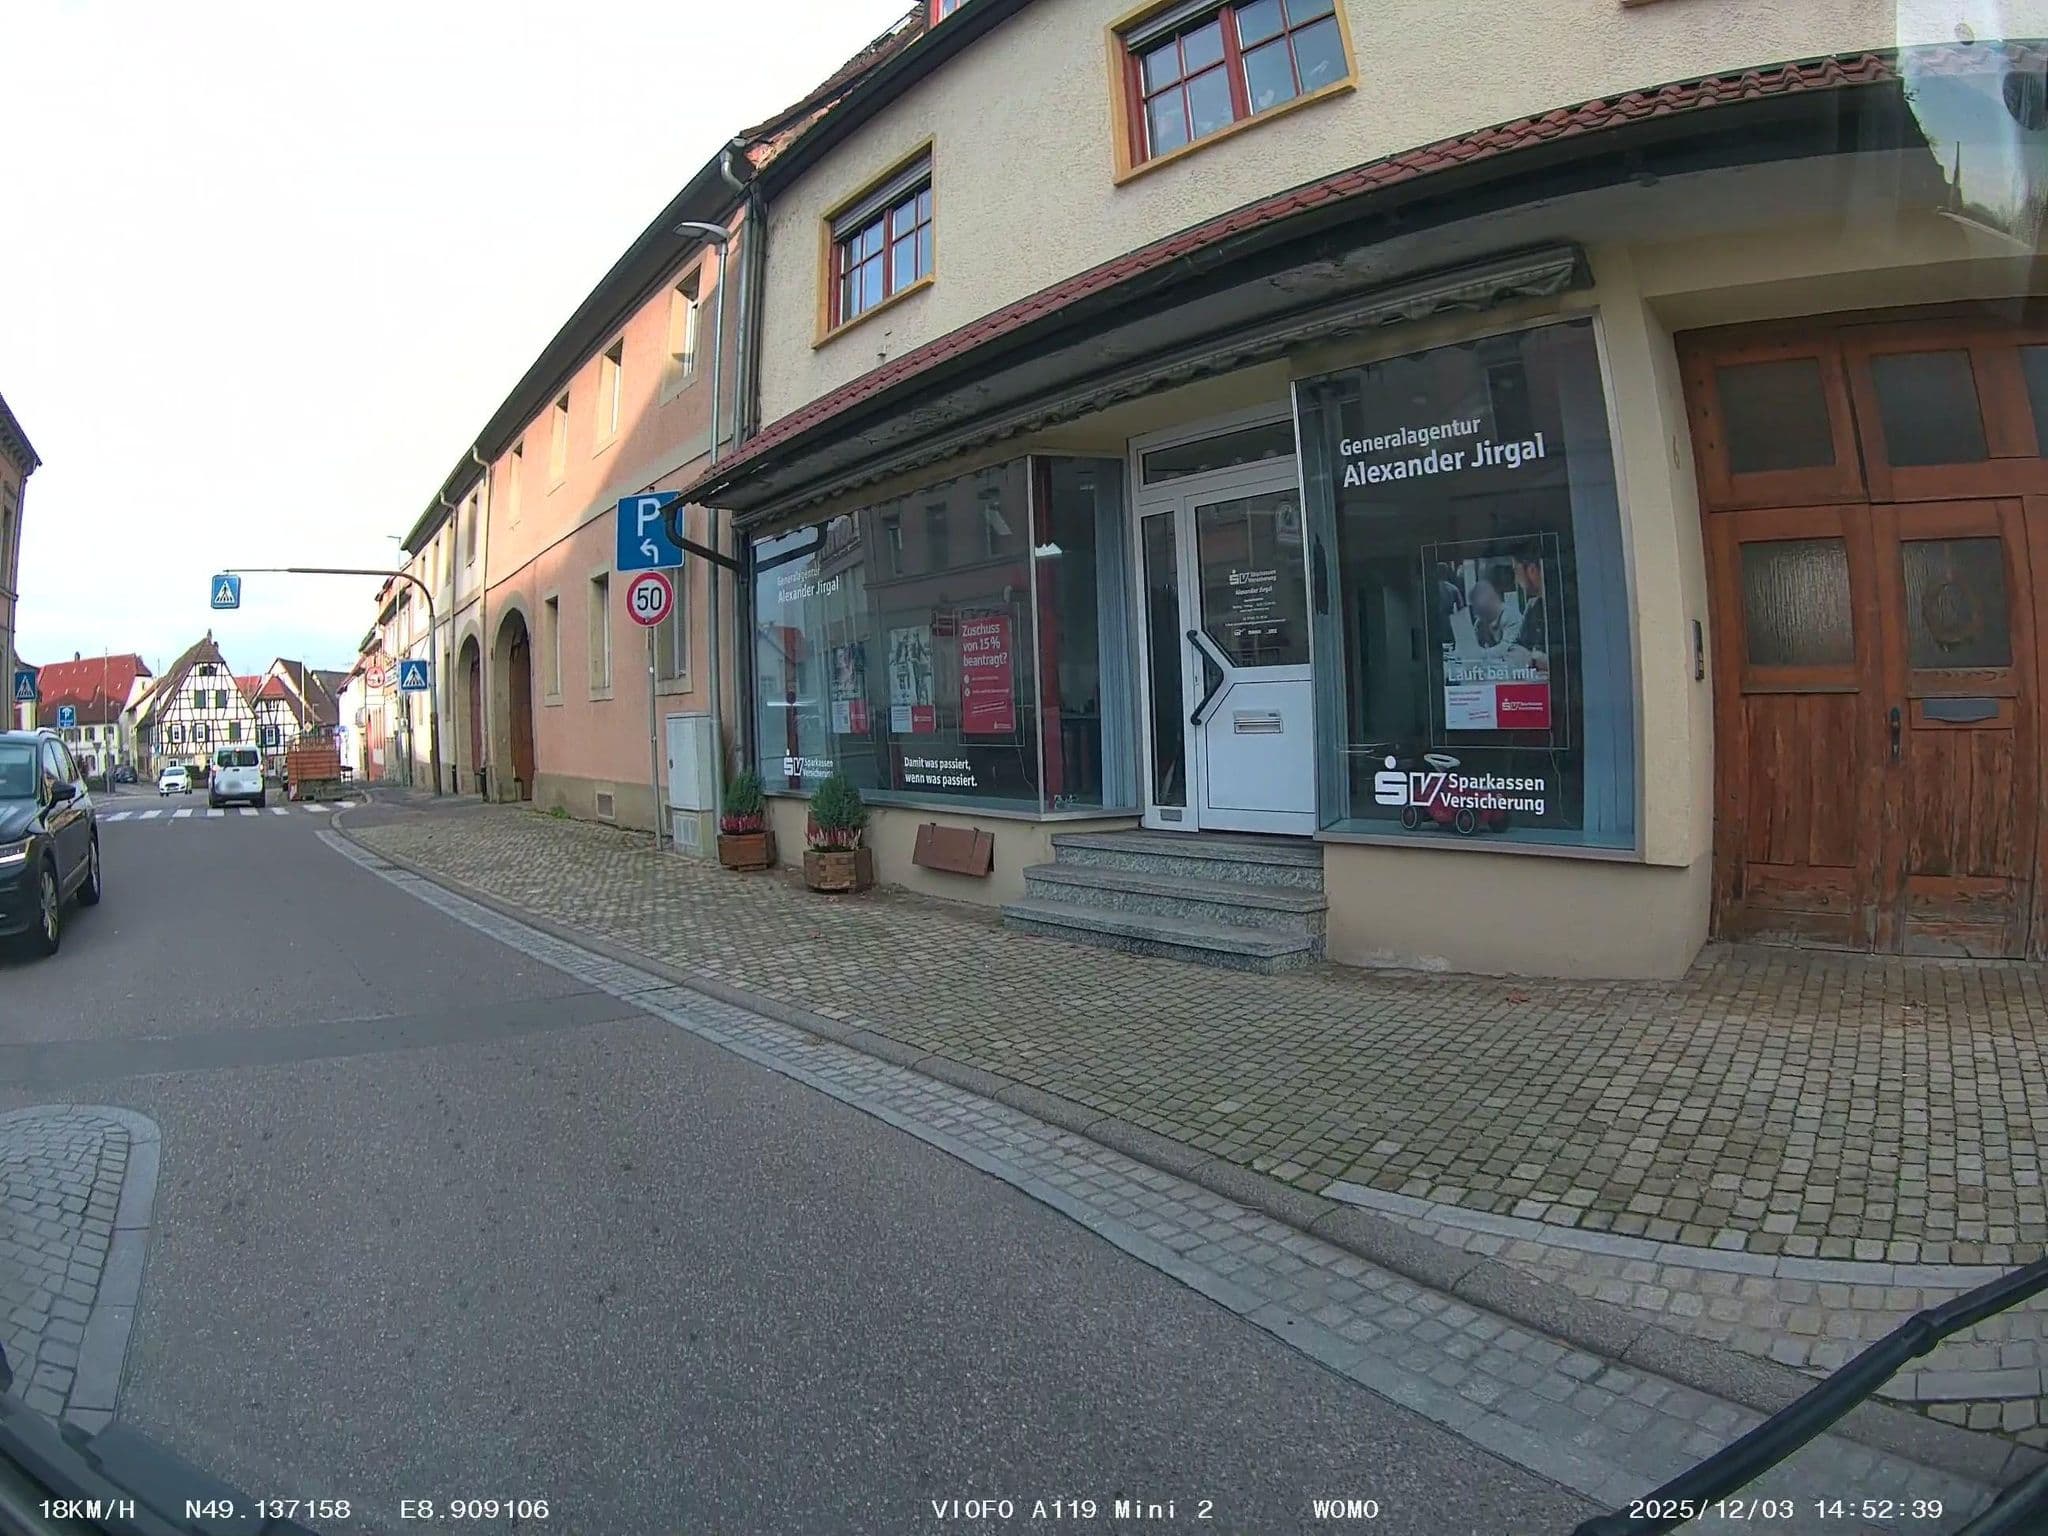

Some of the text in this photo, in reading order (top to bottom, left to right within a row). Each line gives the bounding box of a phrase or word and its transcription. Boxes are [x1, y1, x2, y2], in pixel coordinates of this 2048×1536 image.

[1340, 417, 1481, 456] Generalagentur
[1343, 432, 1546, 488] Alexander Jirgal
[637, 497, 661, 537] P
[636, 587, 662, 611] 50
[777, 575, 839, 604] Alexander Jirgal
[962, 623, 1000, 637] Zuschuss
[963, 643, 978, 652] von
[963, 652, 1008, 668] beantragt?
[1487, 664, 1510, 680] bei
[904, 756, 972, 771] Damit was passiert,
[905, 773, 978, 788] wenn was passiert.
[1448, 772, 1545, 792] Sparkassen
[1440, 792, 1545, 815] Versicherung
